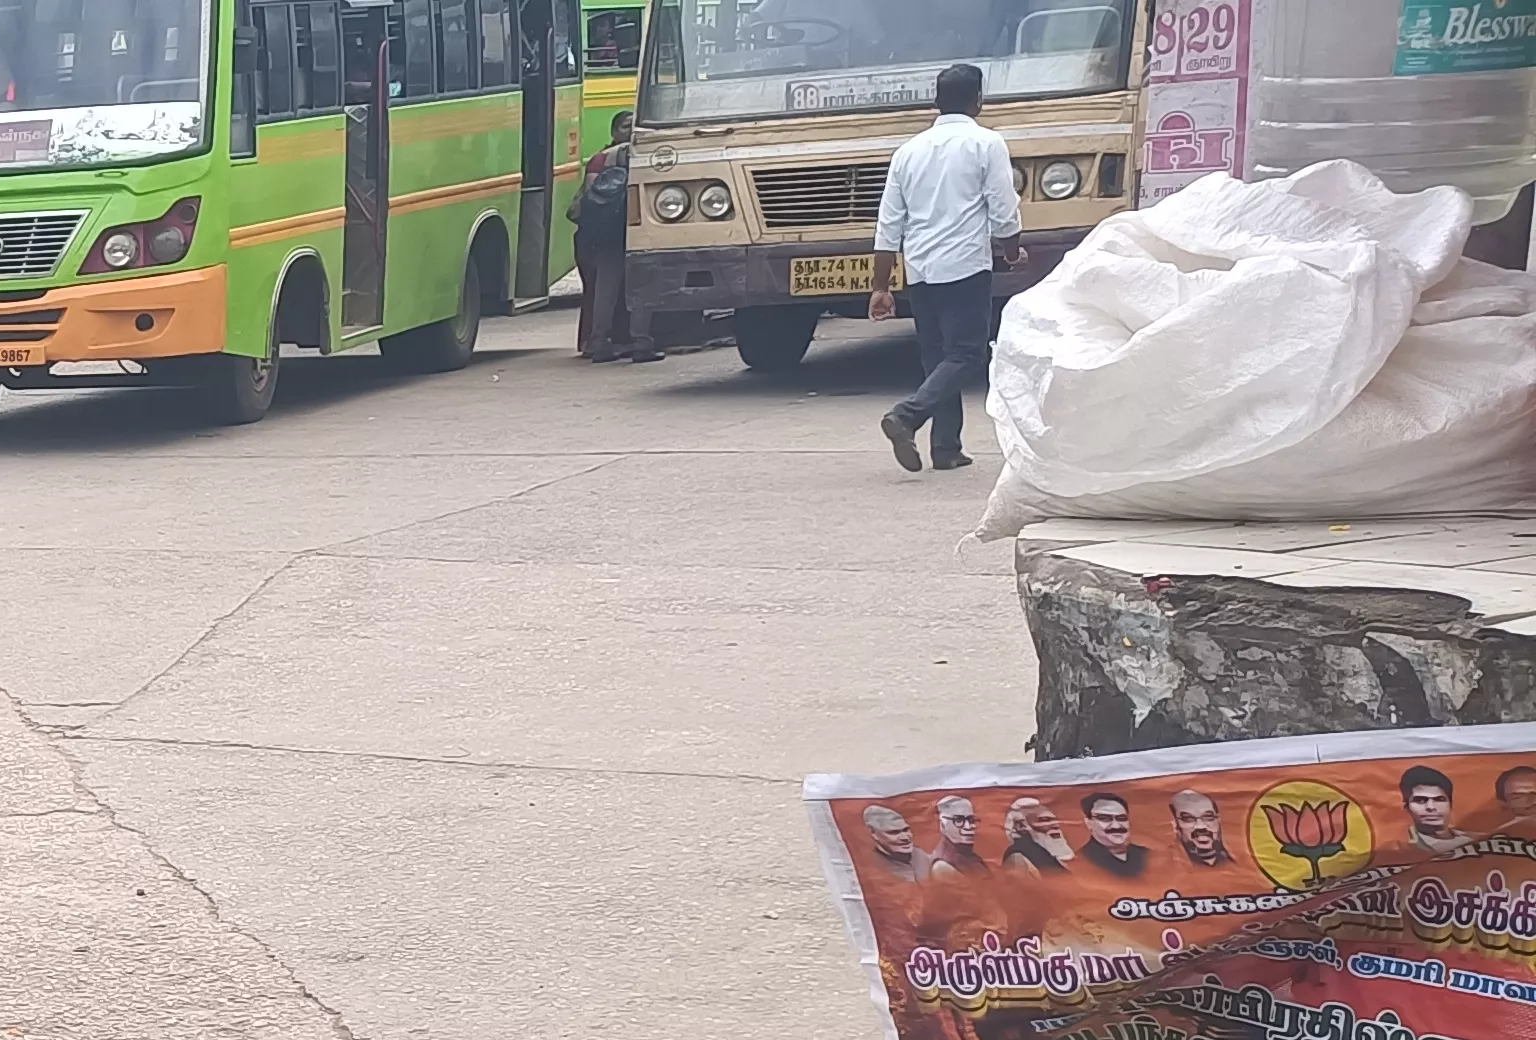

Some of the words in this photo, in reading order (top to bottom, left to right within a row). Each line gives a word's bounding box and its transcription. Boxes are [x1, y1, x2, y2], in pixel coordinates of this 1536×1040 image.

[1186, 4, 1236, 54] 29
[905, 930, 1082, 1000] அருள்மிகு
[1347, 950, 1447, 990] குமரி
